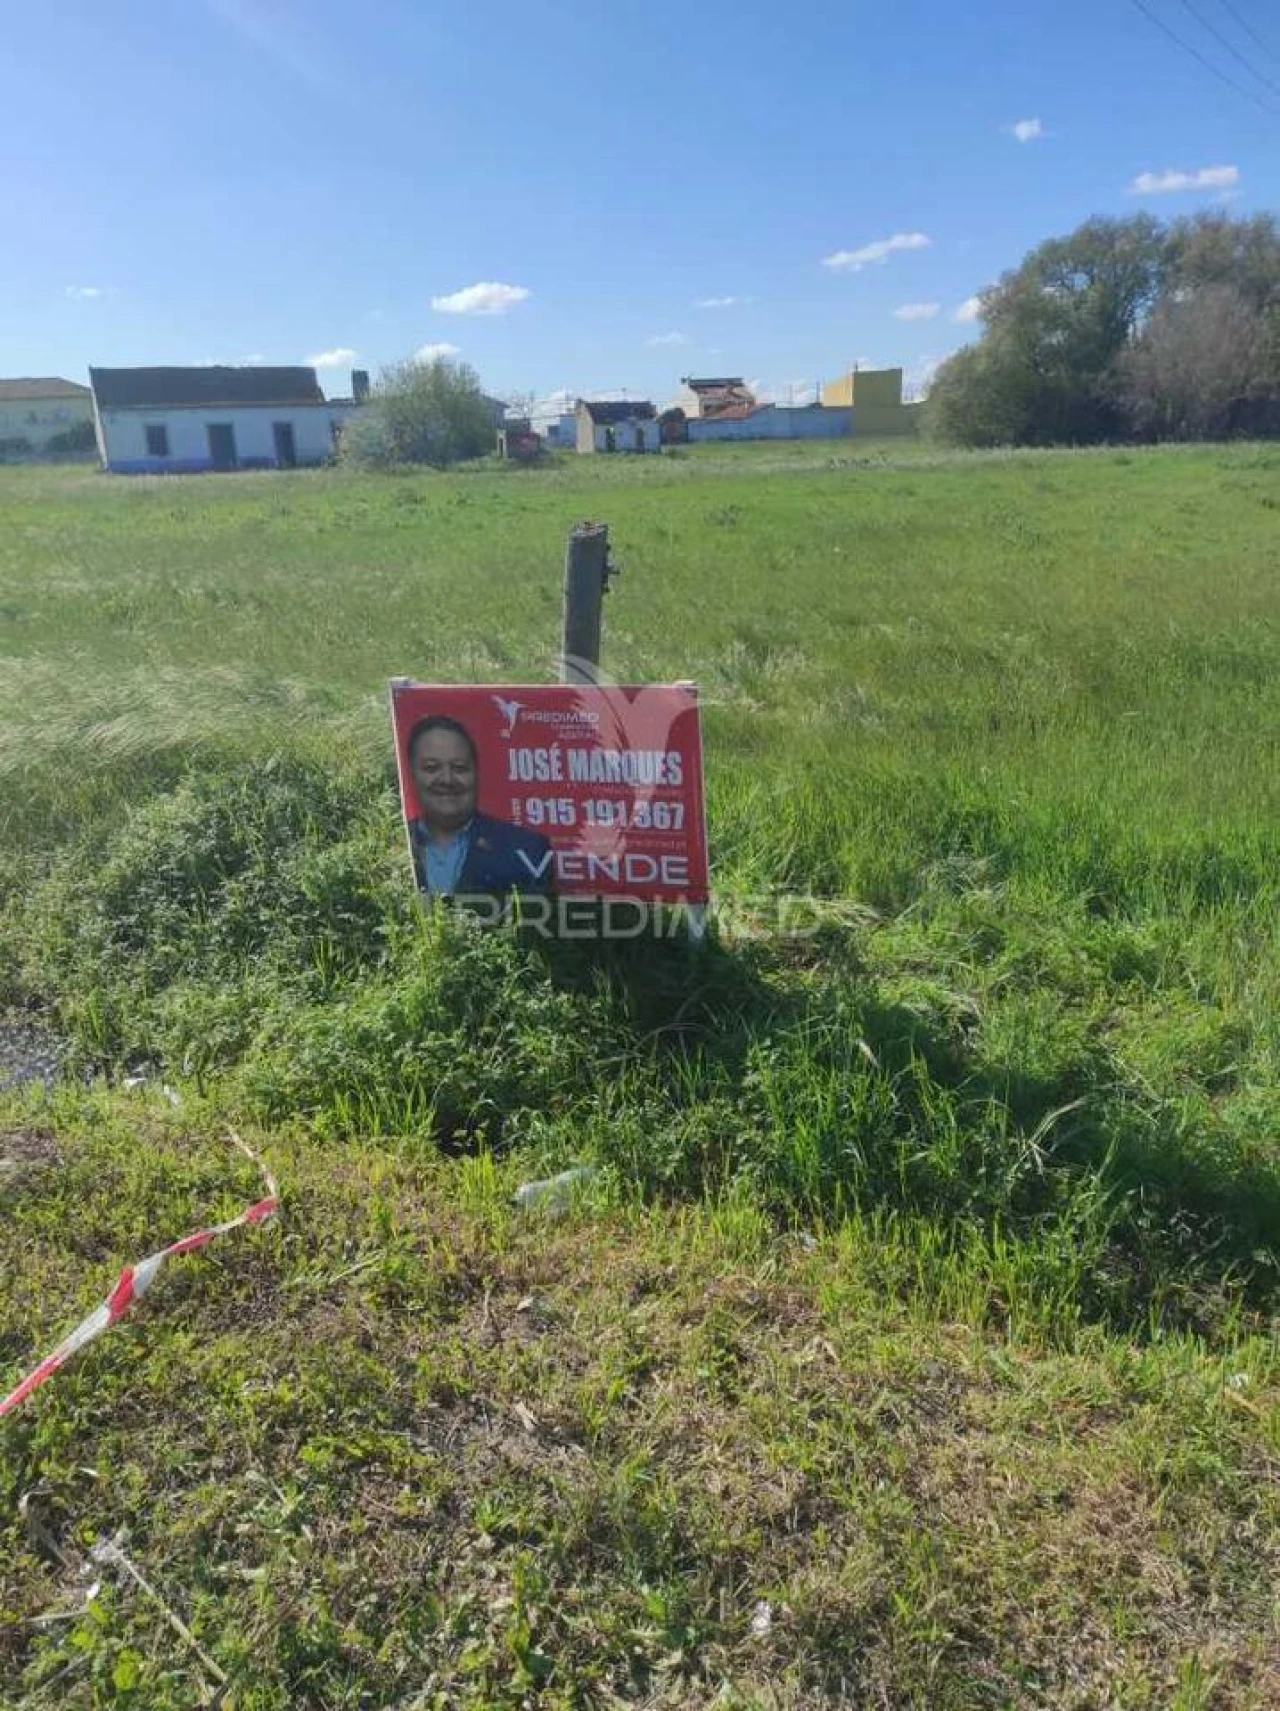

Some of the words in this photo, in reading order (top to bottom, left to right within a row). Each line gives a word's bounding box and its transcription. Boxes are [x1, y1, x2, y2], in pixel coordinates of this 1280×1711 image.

[508, 743, 563, 781] JOSÉ
[567, 749, 683, 785] MARQUES
[525, 798, 577, 826] 915
[583, 799, 627, 827] 191
[632, 801, 685, 830] 367
[516, 850, 690, 885] VENDE
